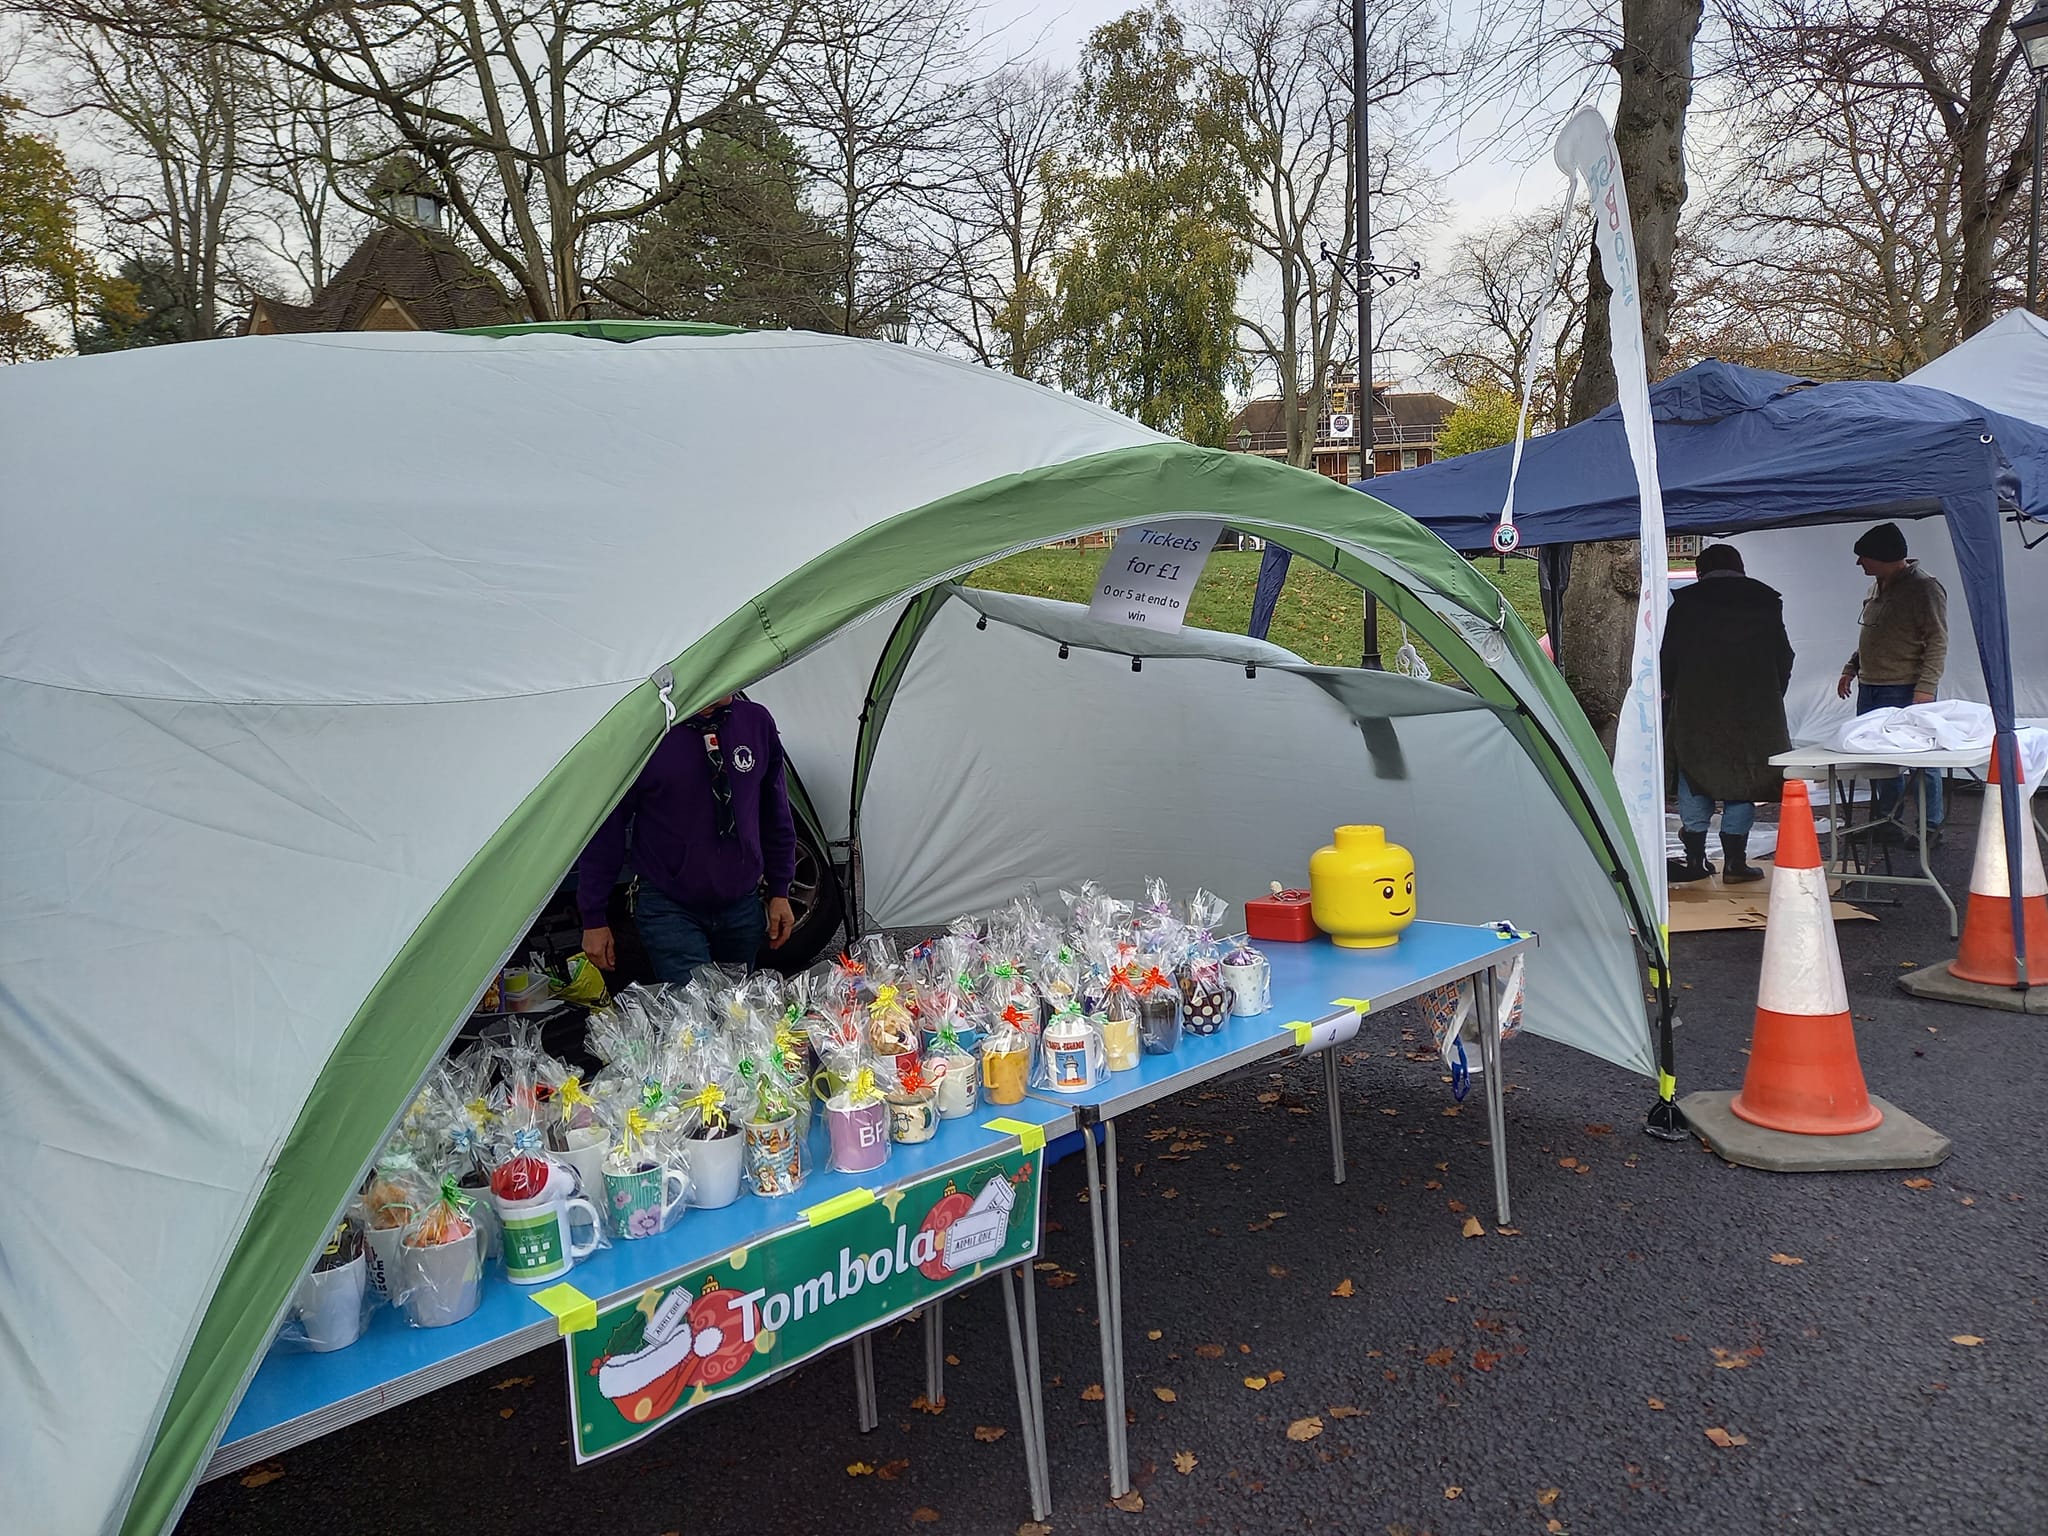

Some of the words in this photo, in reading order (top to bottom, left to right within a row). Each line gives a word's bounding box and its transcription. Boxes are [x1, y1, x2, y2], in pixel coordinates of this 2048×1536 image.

[1140, 529, 1201, 551] Tickets
[1126, 556, 1155, 575] for
[1156, 563, 1181, 581] £1
[1103, 584, 1112, 595] 0
[1112, 588, 1125, 598] or
[1126, 589, 1133, 600] 5
[1135, 591, 1146, 602] at
[1147, 594, 1167, 606] end
[1168, 597, 1180, 609] to
[1127, 610, 1146, 623] win
[954, 1235, 977, 1250] ADMIT
[727, 1223, 938, 1343] Tombola
